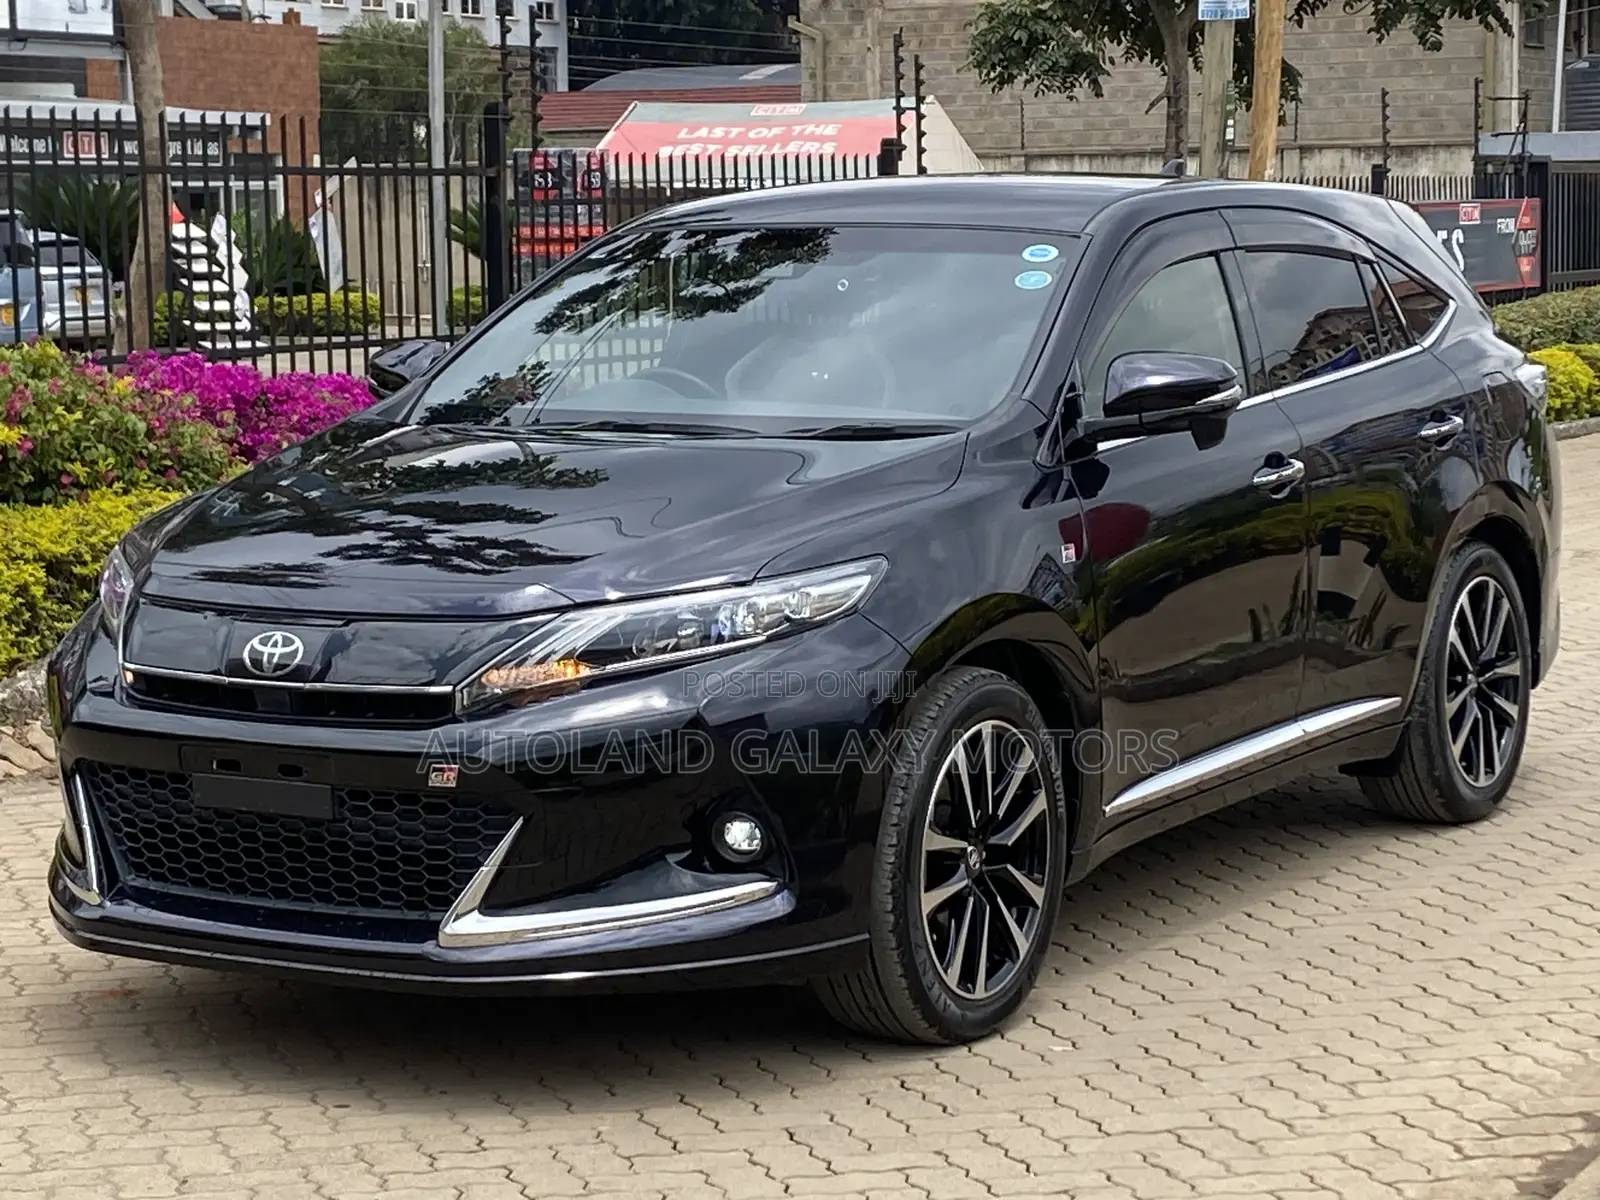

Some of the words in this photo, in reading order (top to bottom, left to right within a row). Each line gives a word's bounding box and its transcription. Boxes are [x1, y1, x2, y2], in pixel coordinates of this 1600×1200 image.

[677, 127, 746, 139] LAST
[748, 126, 787, 139] OF
[792, 123, 843, 136] THE
[659, 143, 722, 158] BEST
[724, 141, 838, 157] SELLERS
[430, 771, 457, 782] GR
